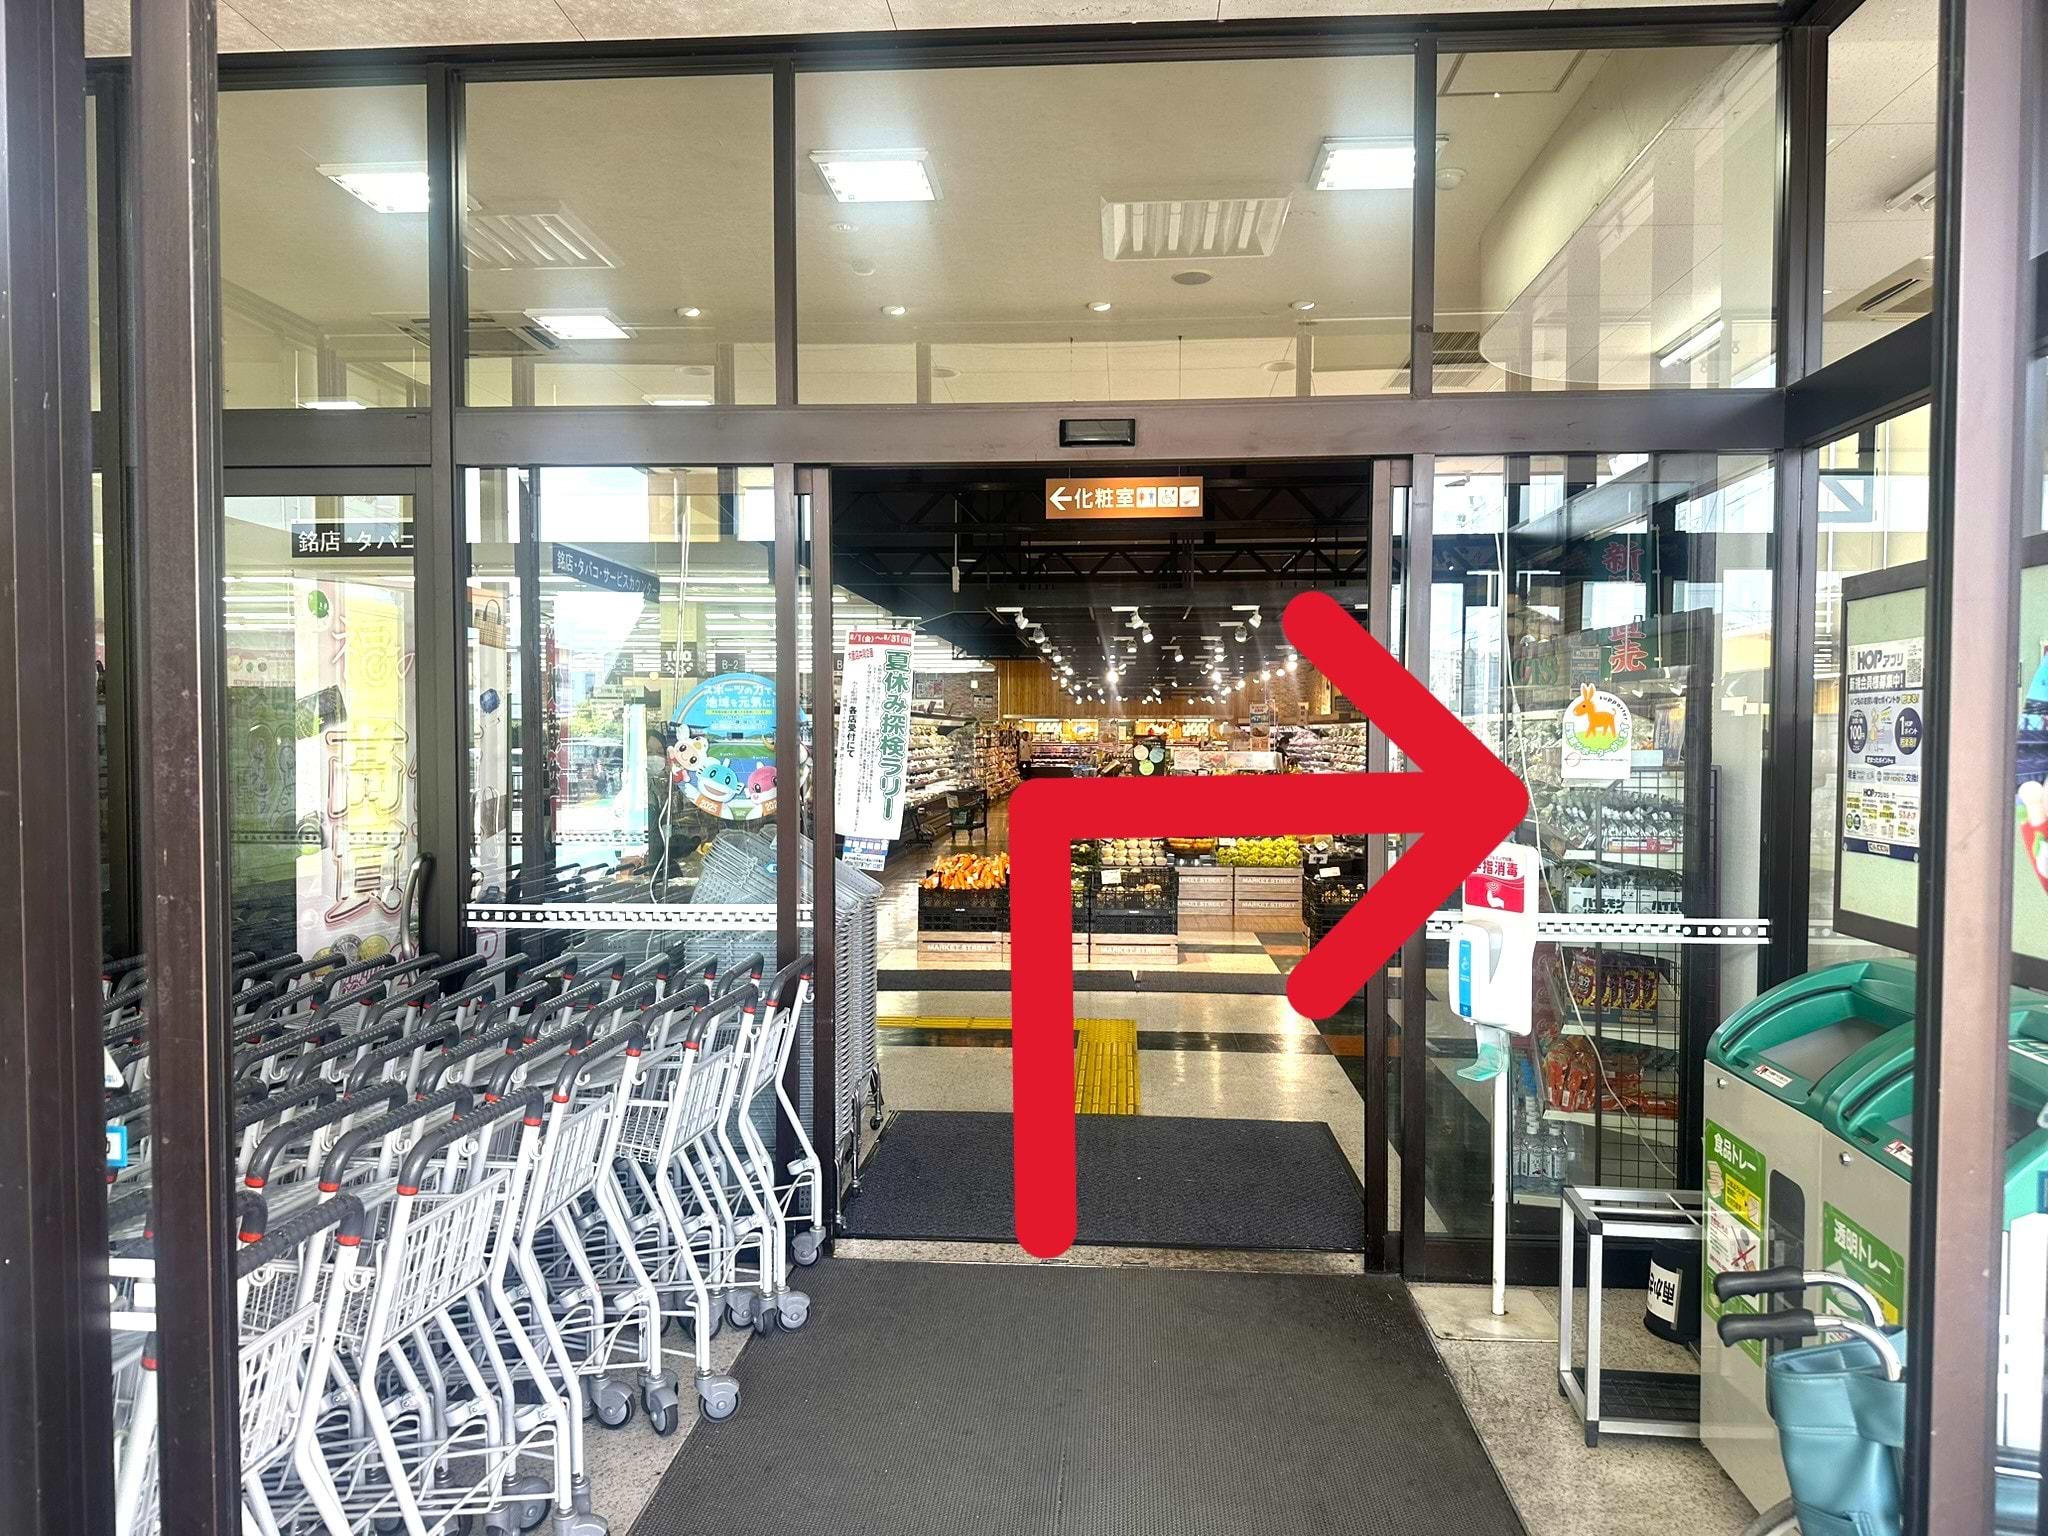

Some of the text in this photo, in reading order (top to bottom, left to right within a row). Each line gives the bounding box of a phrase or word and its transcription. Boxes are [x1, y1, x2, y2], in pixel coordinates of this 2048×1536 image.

[1074, 487, 1135, 509] 化粧室
[721, 660, 739, 670] B-2
[703, 685, 776, 696] スポーツの力で、
[706, 696, 775, 708] 地域を元気に!
[1600, 696, 1628, 721] supporter
[881, 650, 911, 820] 夏休み探検ラリー
[699, 799, 718, 813] 2025
[1473, 859, 1519, 877] 指消毒
[1100, 946, 1132, 954] MARKET
[1714, 1133, 1757, 1172] 食品トレー
[1833, 1218, 1891, 1274] 透明トレー
